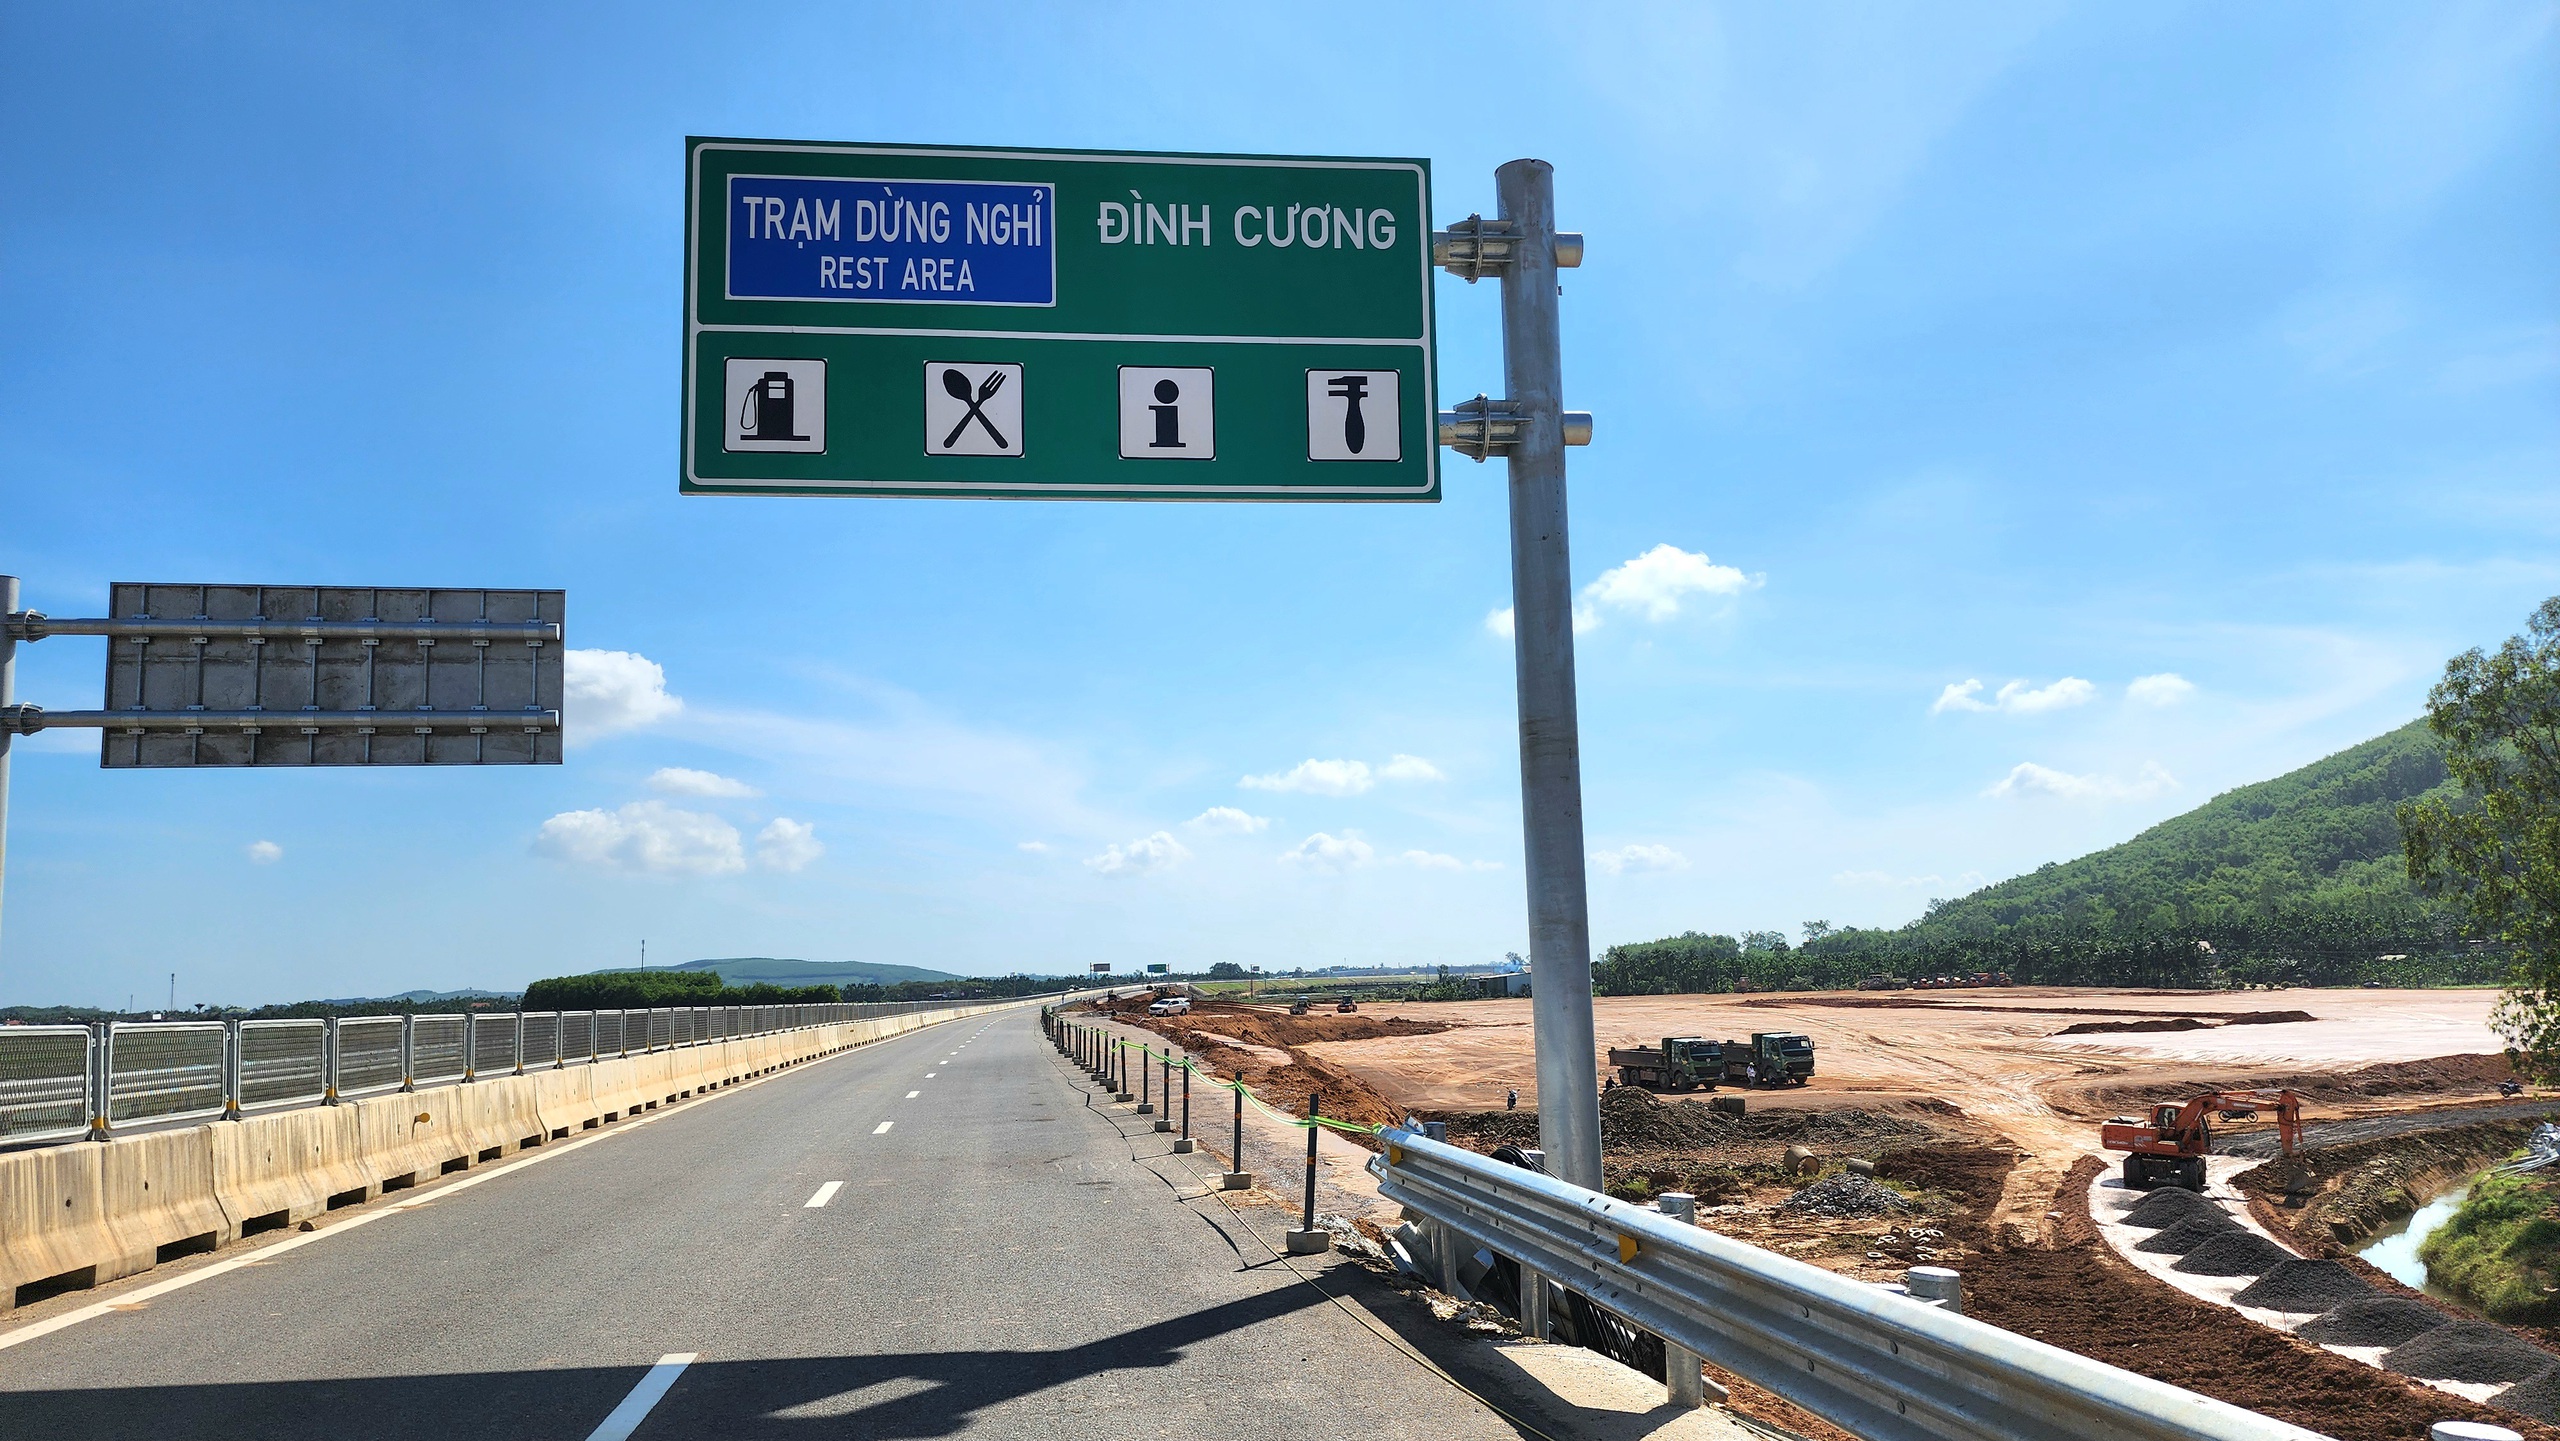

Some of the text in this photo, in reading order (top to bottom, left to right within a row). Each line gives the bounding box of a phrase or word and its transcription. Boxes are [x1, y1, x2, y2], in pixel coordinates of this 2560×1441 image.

[743, 186, 1044, 249] TRẠM DỪNG NGHỈ
[1097, 189, 1396, 250] ĐÌNH CƯƠNG
[820, 255, 975, 292] REST AREA
